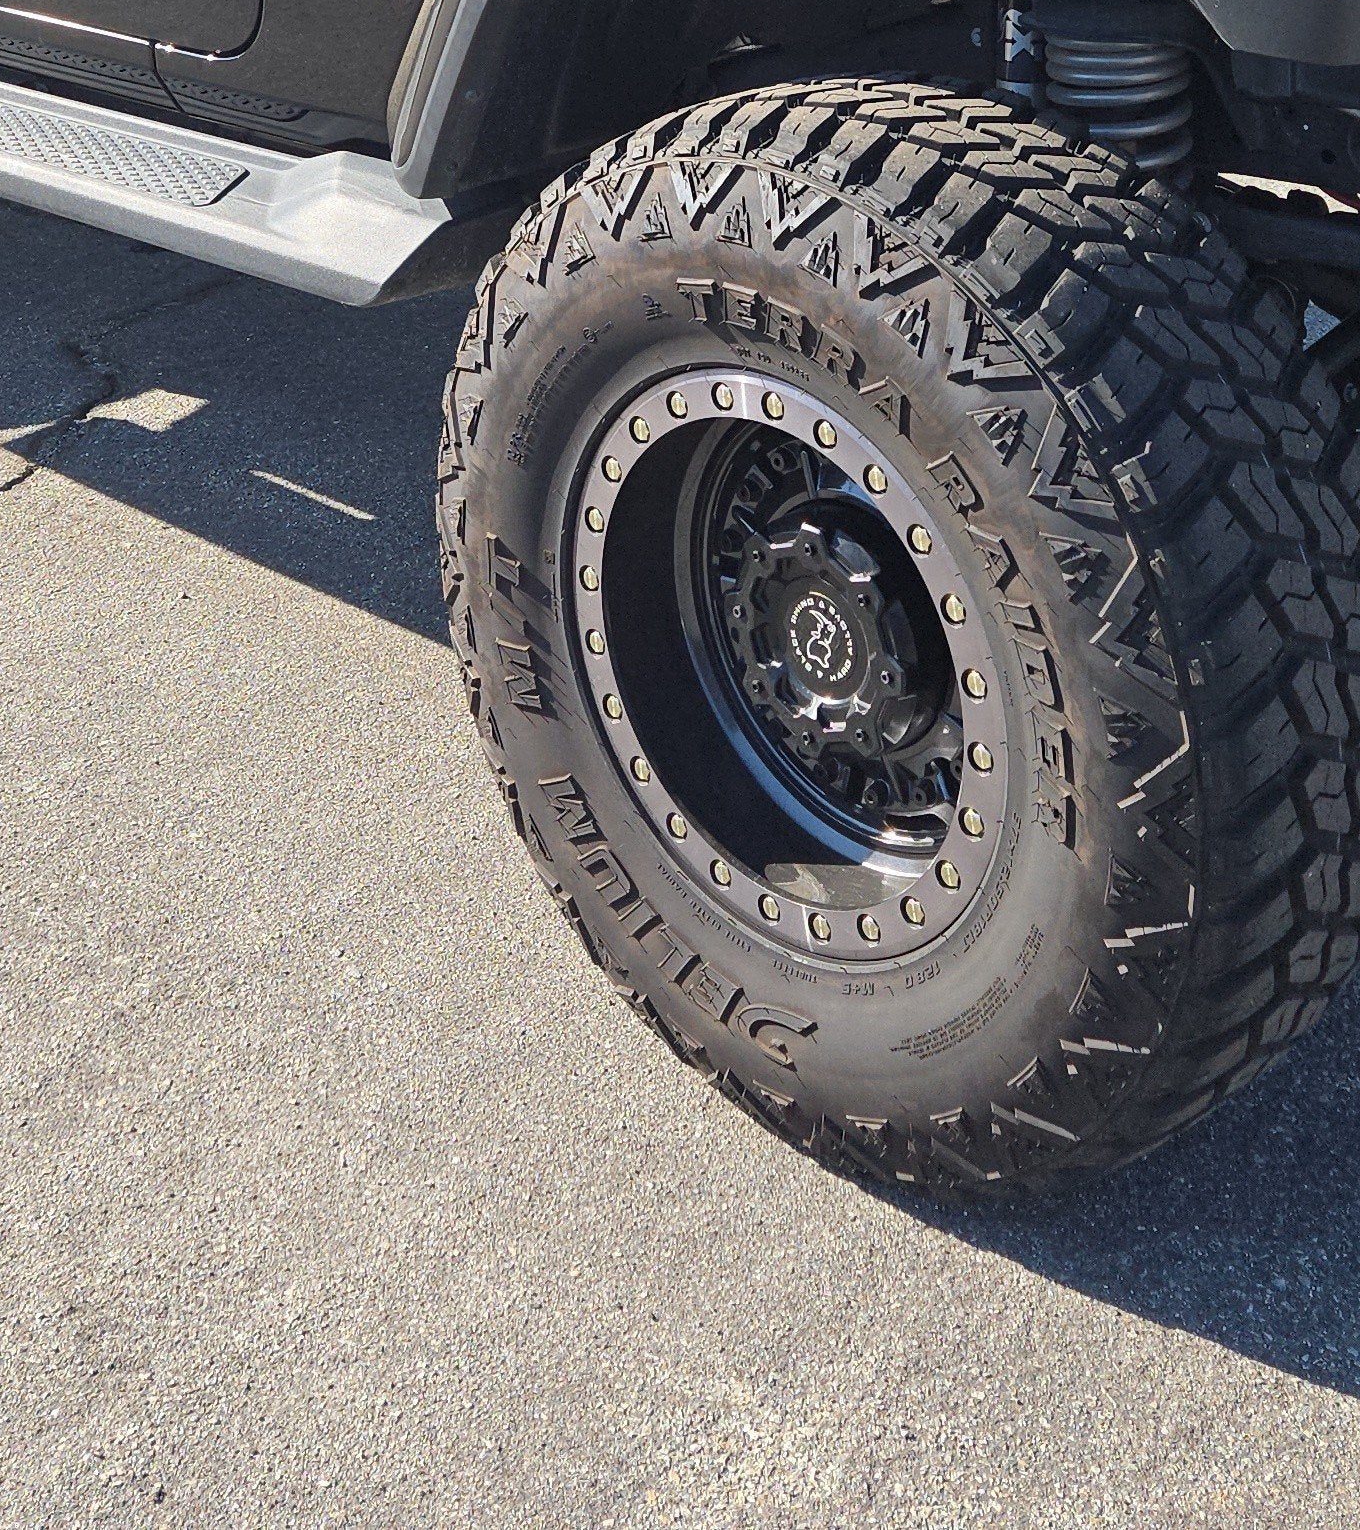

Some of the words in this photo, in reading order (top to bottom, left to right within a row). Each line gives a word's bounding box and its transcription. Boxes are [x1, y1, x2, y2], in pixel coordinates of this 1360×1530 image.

[675, 276, 906, 437] TERRA
[926, 450, 1075, 846] RAIDER
[537, 773, 818, 1066] DELIUM
